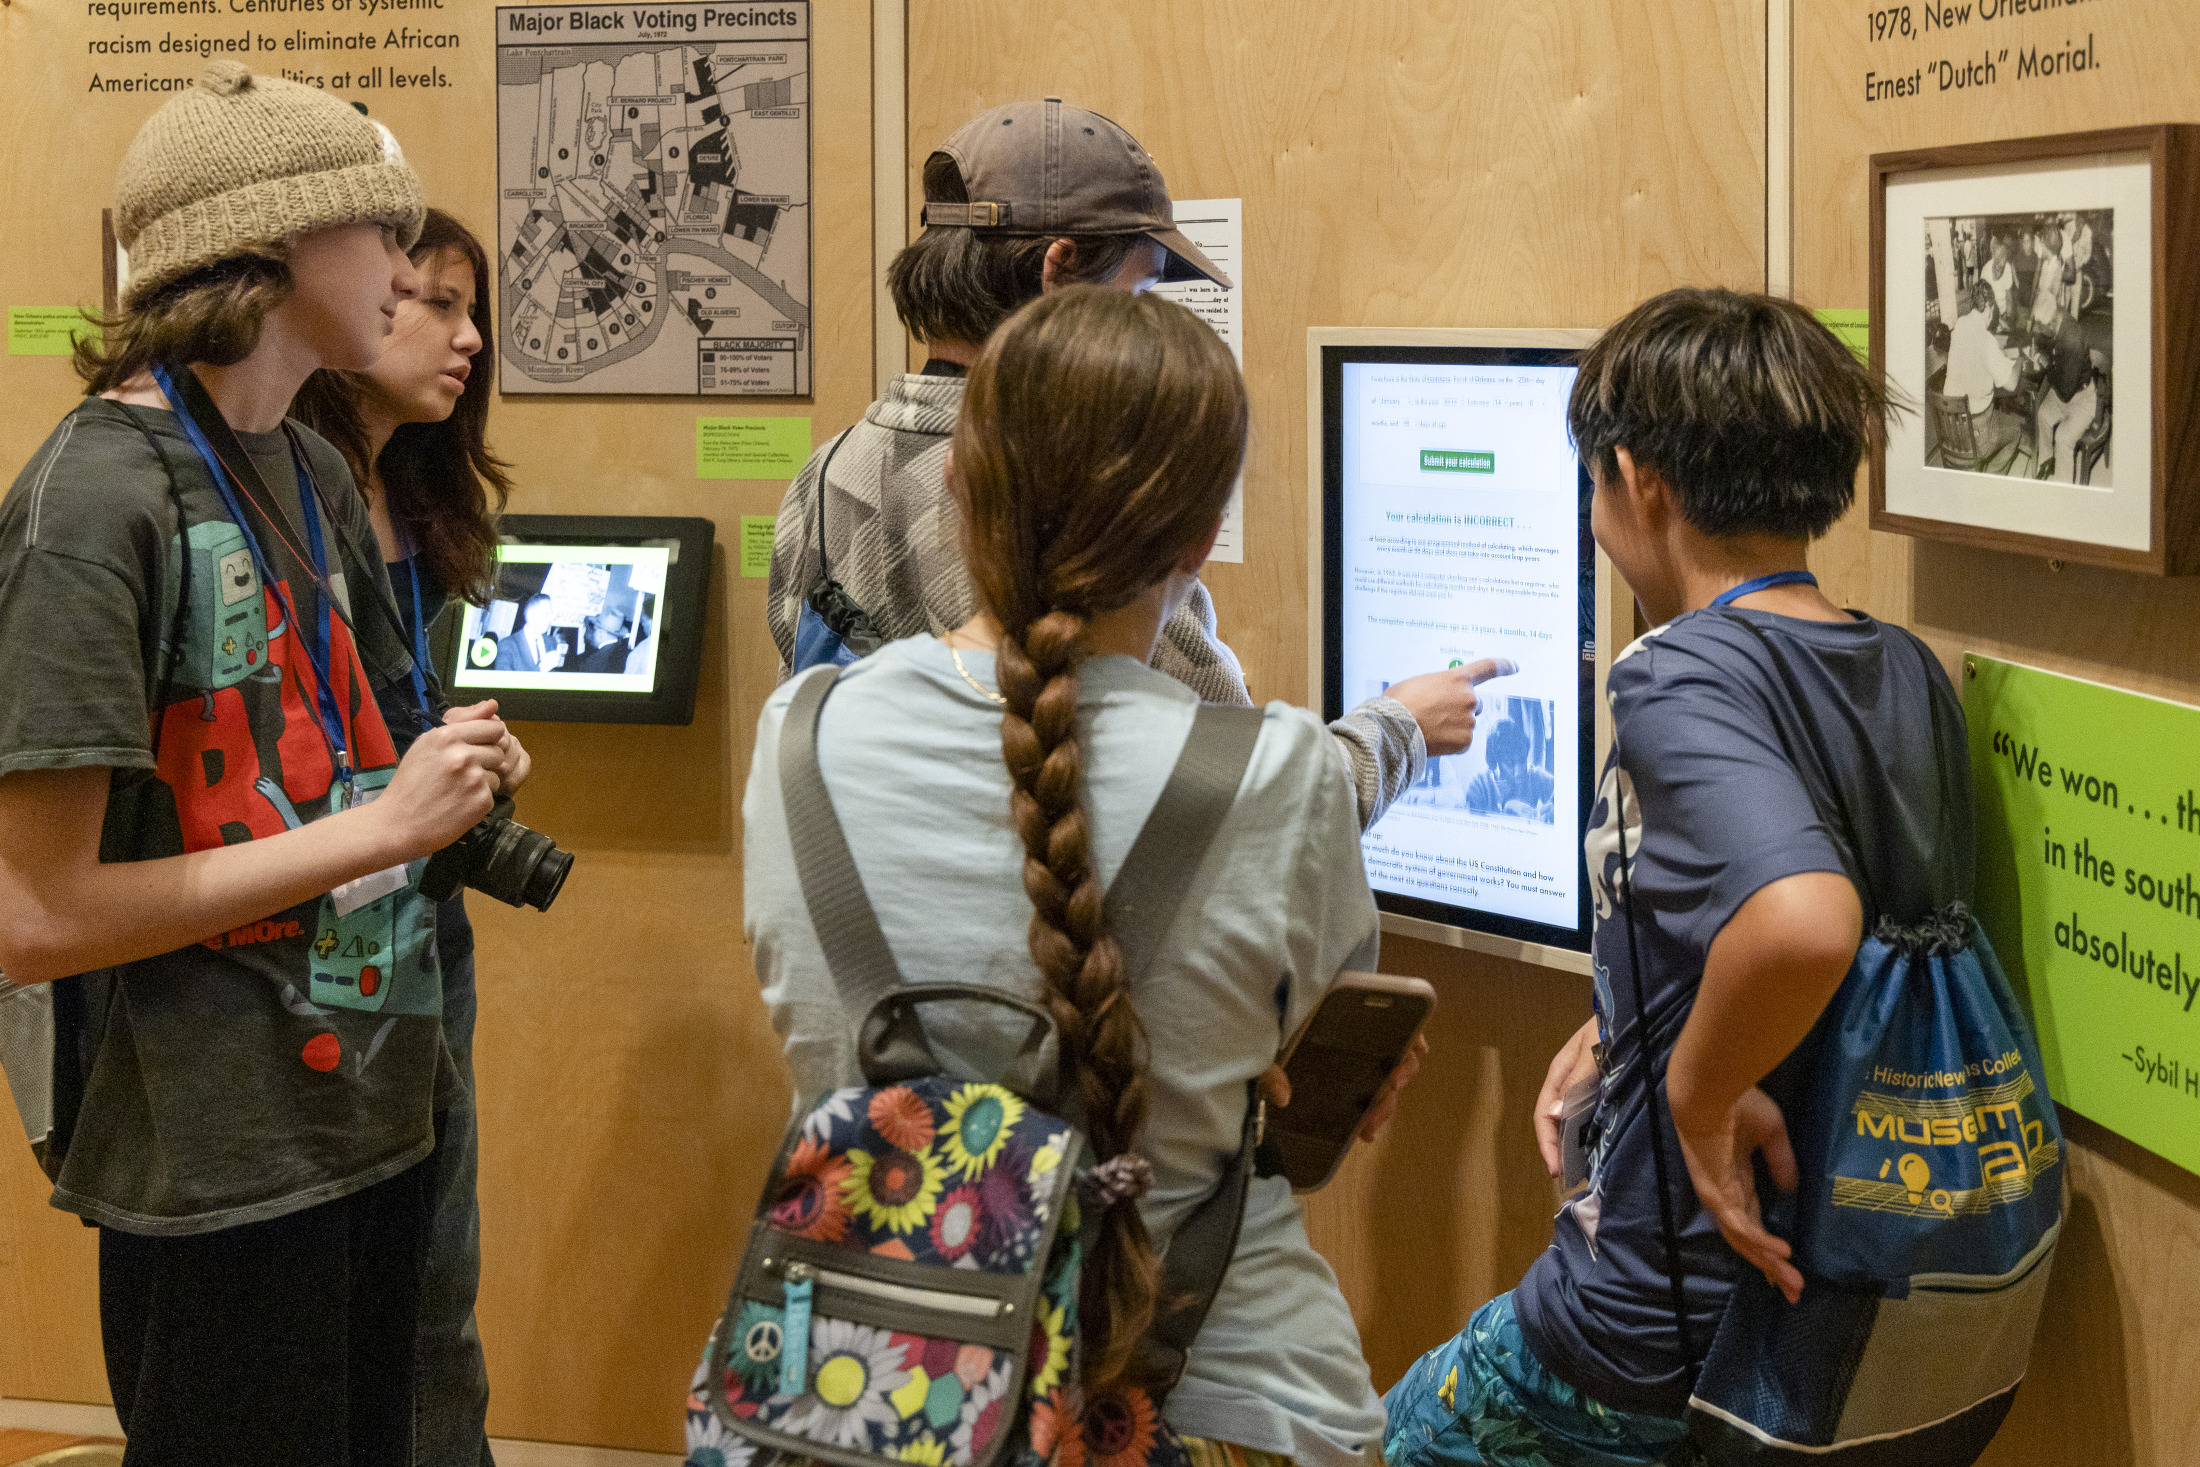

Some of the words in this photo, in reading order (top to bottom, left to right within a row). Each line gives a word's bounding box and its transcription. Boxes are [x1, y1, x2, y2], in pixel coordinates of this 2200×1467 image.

[510, 13, 563, 35] Major
[570, 11, 624, 30] Black
[633, 9, 697, 32] Voting
[704, 8, 797, 27] Precincts
[1868, 7, 1917, 41] 1978,
[1926, 2, 1972, 31] New
[89, 34, 151, 54] racism
[160, 30, 250, 57] designed
[257, 35, 276, 52] to
[285, 30, 376, 51] eliminate
[384, 27, 459, 49] African
[89, 71, 194, 92] Americans
[332, 73, 351, 87] at
[358, 67, 382, 88] all
[390, 66, 452, 88] levels.
[1866, 69, 1921, 102] Ernest
[2018, 33, 2099, 80] Morial.
[714, 341, 741, 350] BLACK
[743, 340, 784, 349] MAJORITY
[1424, 454, 1444, 467] Submit
[1446, 456, 1457, 469] your
[1386, 511, 1404, 522] Your
[1407, 511, 1451, 525] calculation
[1454, 513, 1462, 524] is
[1464, 514, 1514, 528] INCORRECT
[1367, 615, 1378, 624] The
[1993, 730, 2052, 787] “We
[2060, 767, 2117, 809] won
[1391, 847, 1400, 856] do
[1401, 849, 1414, 859] you
[1416, 849, 1434, 862] know
[1435, 853, 1455, 865] about
[1456, 856, 1468, 867] the
[1469, 859, 1479, 868] US
[1480, 861, 1522, 876] Constitution
[1523, 870, 1537, 879] and
[1538, 871, 1554, 882] how
[2044, 826, 2065, 869] in
[2074, 838, 2114, 886] the
[1368, 856, 1403, 869] democratic
[1405, 864, 1428, 875] system
[1437, 869, 1478, 883] government
[1479, 876, 1505, 887] works?
[1506, 880, 1520, 890] You
[1521, 884, 1538, 893] must
[1540, 887, 1566, 899] answer
[1378, 870, 1388, 879] the
[1389, 874, 1404, 884] next
[1405, 876, 1415, 886] six
[1417, 879, 1448, 891] questions
[1450, 884, 1480, 898] correctly.
[2055, 912, 2200, 1012] absolutely
[1873, 1065, 1935, 1088] Historic
